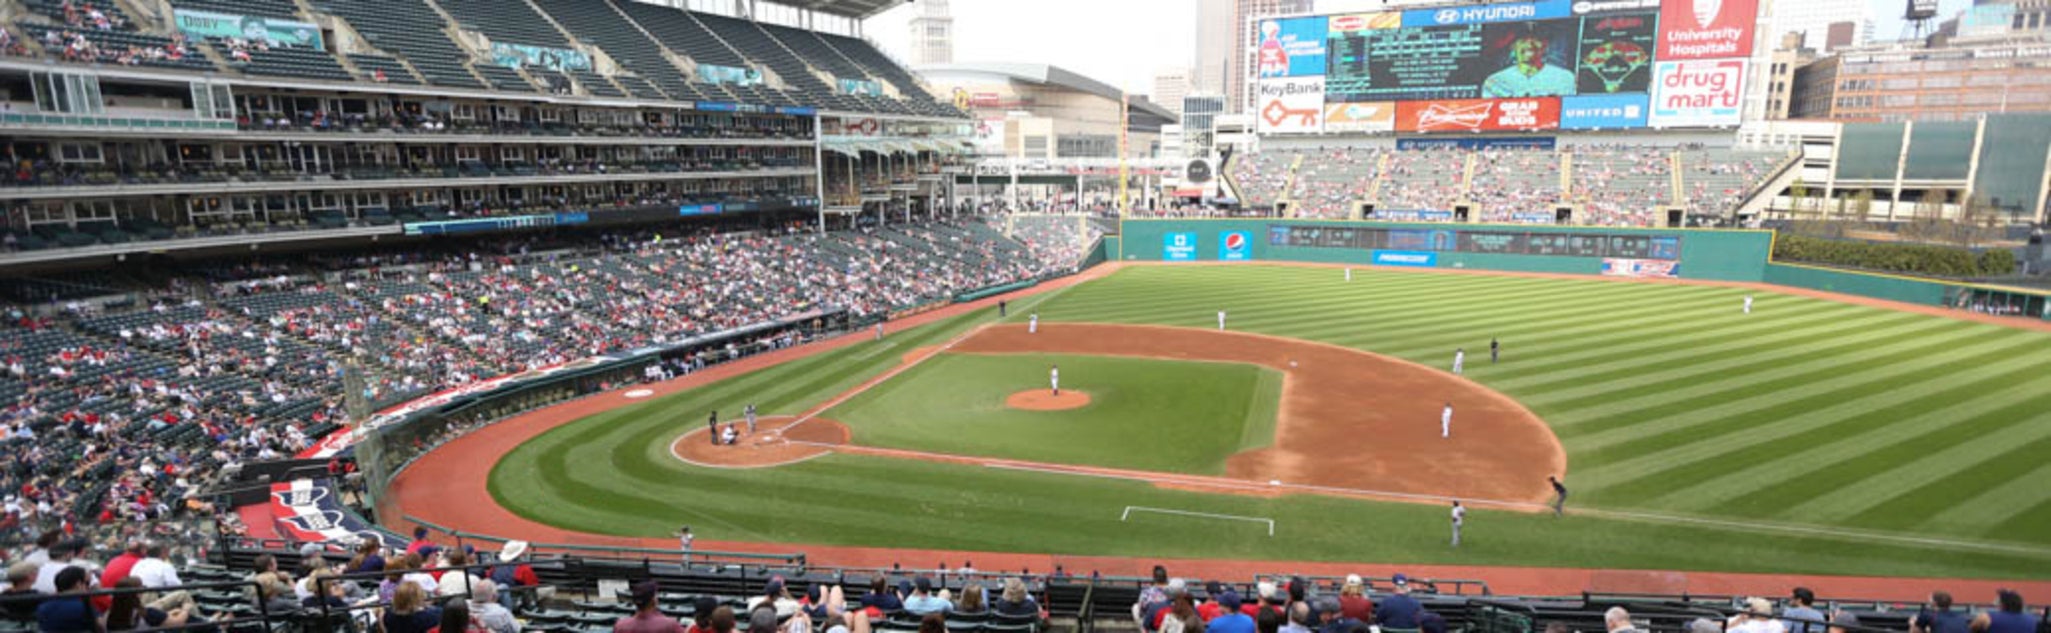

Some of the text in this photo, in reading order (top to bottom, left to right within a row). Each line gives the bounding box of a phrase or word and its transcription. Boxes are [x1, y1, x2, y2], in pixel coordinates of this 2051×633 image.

[1463, 5, 1535, 20] HYUNDAI
[183, 15, 218, 29] DOBY
[1667, 27, 1742, 42] University
[1669, 41, 1737, 56] Hospitals
[1665, 63, 1726, 91] drug
[1261, 83, 1320, 97] KeyBank
[1667, 90, 1737, 107] mart
[1566, 107, 1622, 118] UNITED
